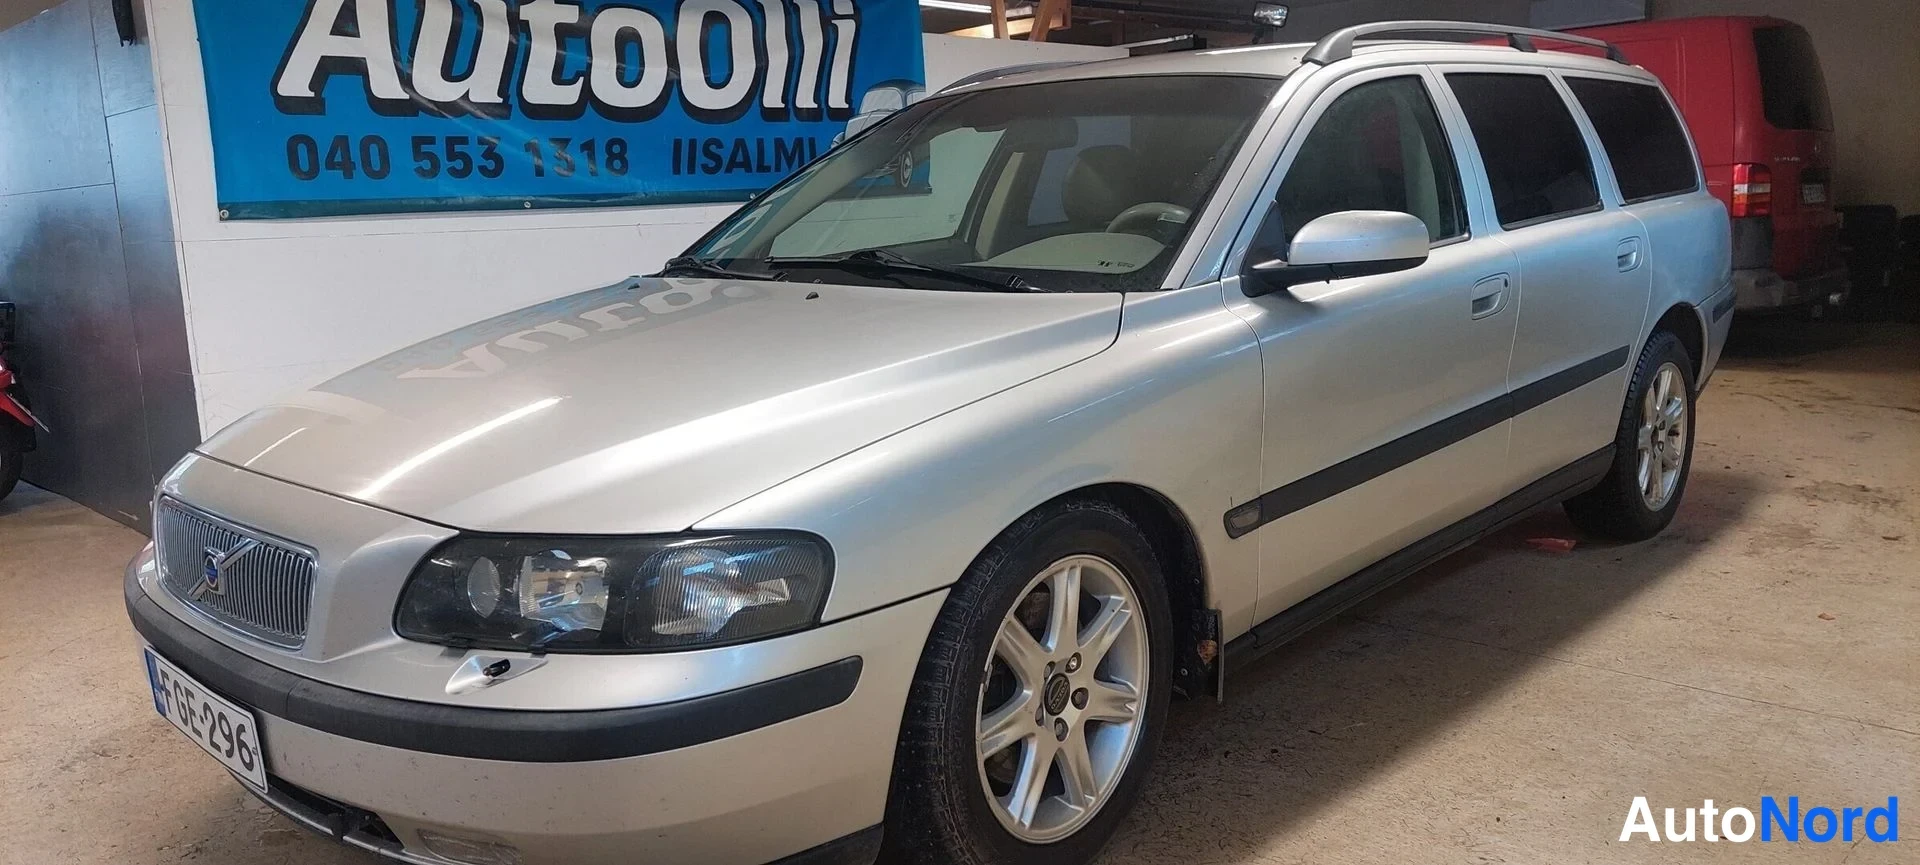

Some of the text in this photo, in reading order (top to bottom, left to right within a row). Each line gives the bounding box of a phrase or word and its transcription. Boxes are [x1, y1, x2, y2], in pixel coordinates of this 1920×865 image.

[286, 135, 817, 180] 040 553 1318 IISALMI
[160, 668, 254, 772] FGE-296
